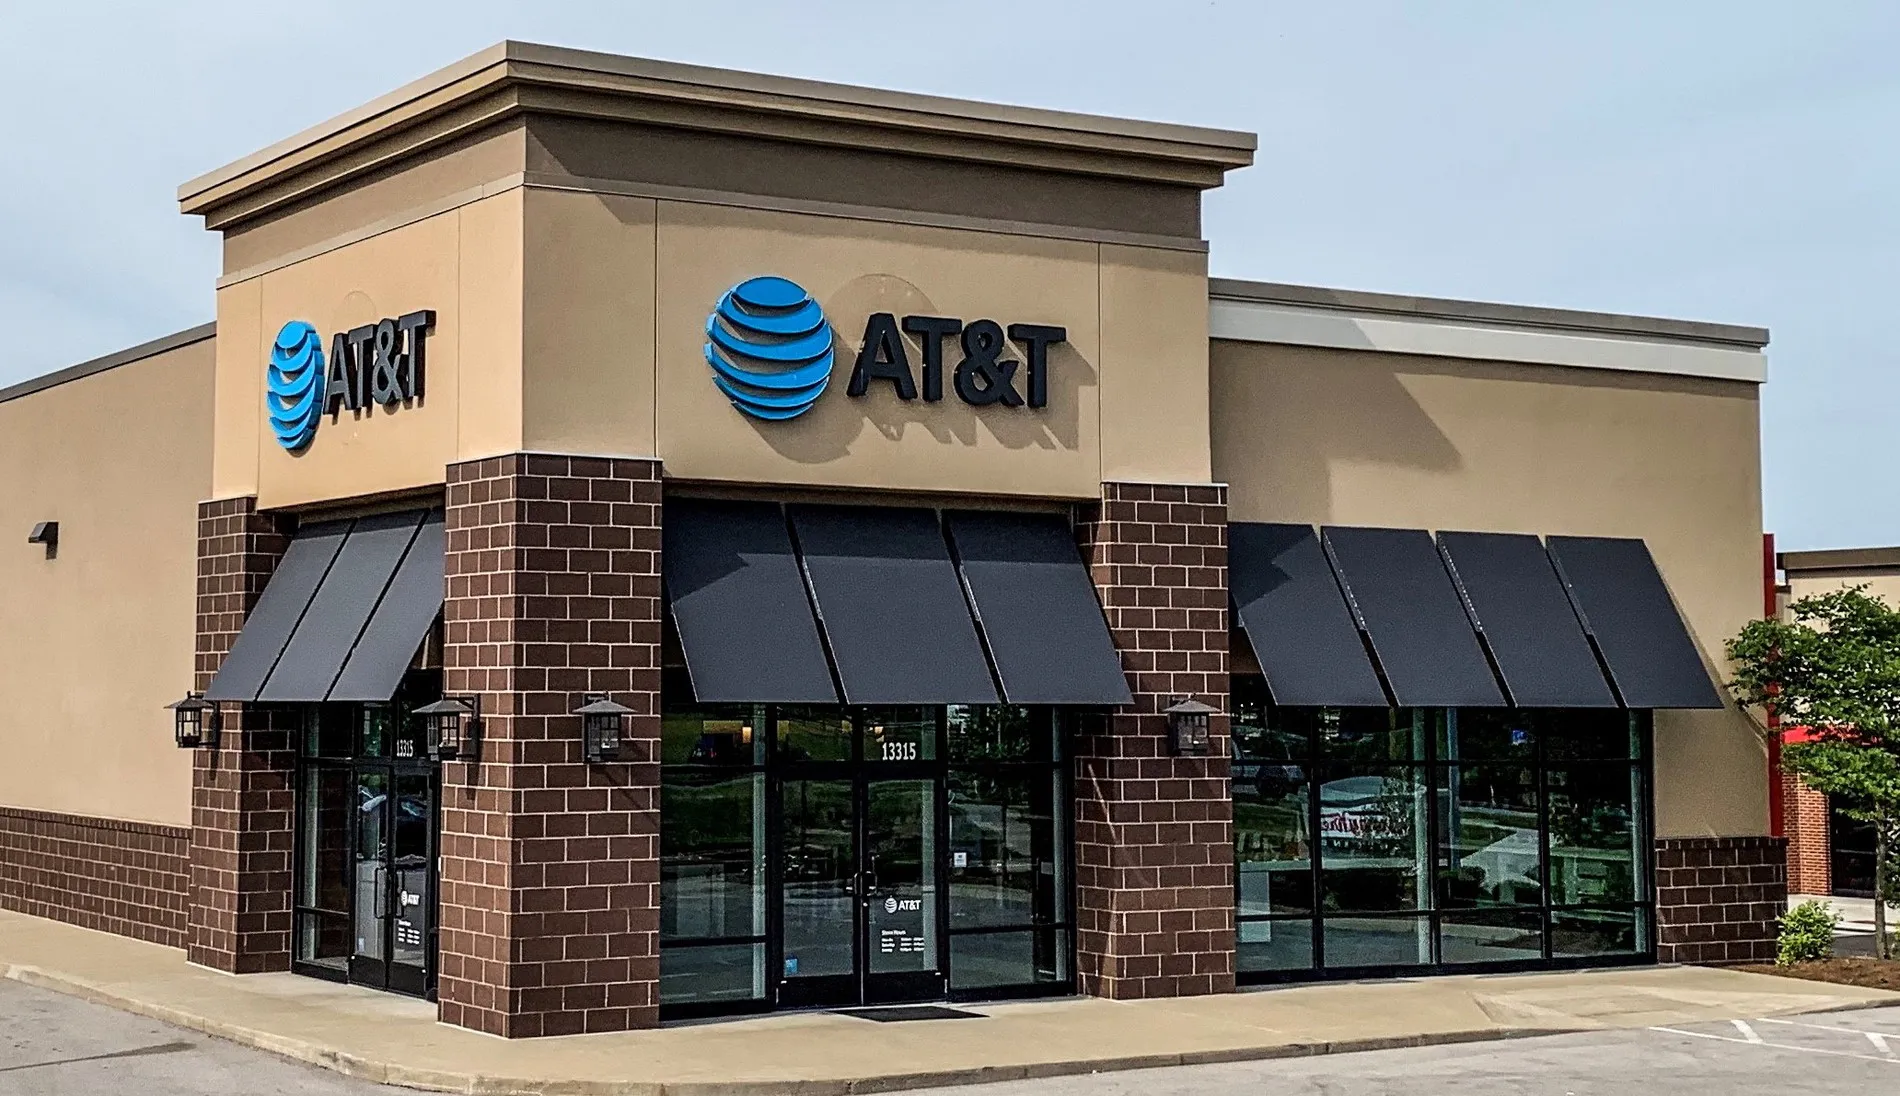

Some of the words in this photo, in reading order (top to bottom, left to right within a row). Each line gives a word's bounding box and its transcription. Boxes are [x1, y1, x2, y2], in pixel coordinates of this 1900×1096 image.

[323, 309, 436, 415] AT&T
[847, 312, 1066, 408] AT&T
[396, 739, 413, 757] 13315
[882, 742, 916, 760] 13315
[898, 899, 921, 911] AT&T
